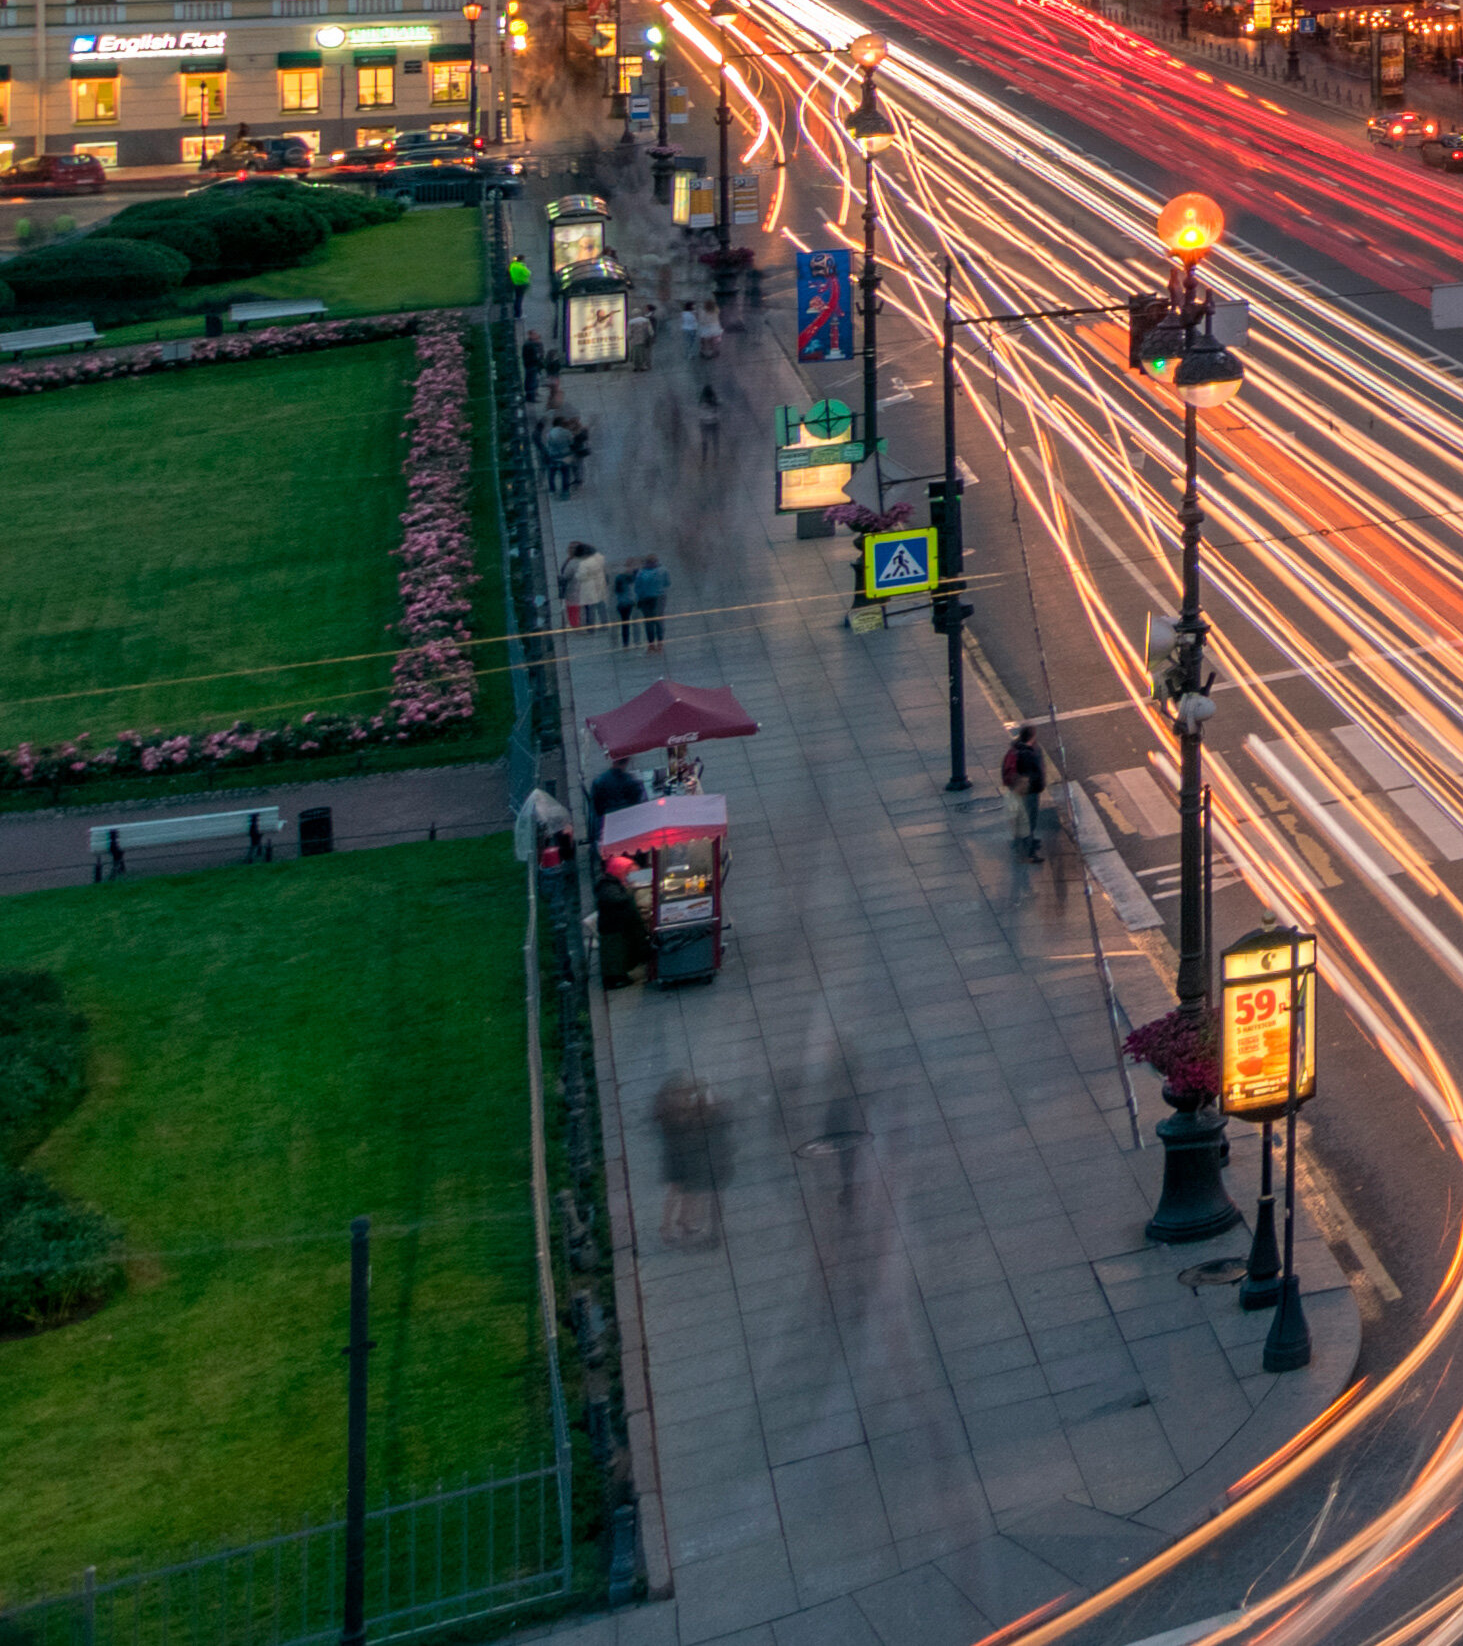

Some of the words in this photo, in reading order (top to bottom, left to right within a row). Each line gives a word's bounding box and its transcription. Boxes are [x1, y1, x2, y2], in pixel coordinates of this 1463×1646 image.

[98, 33, 177, 52] English
[179, 31, 227, 48] First
[1235, 988, 1277, 1026] 59
